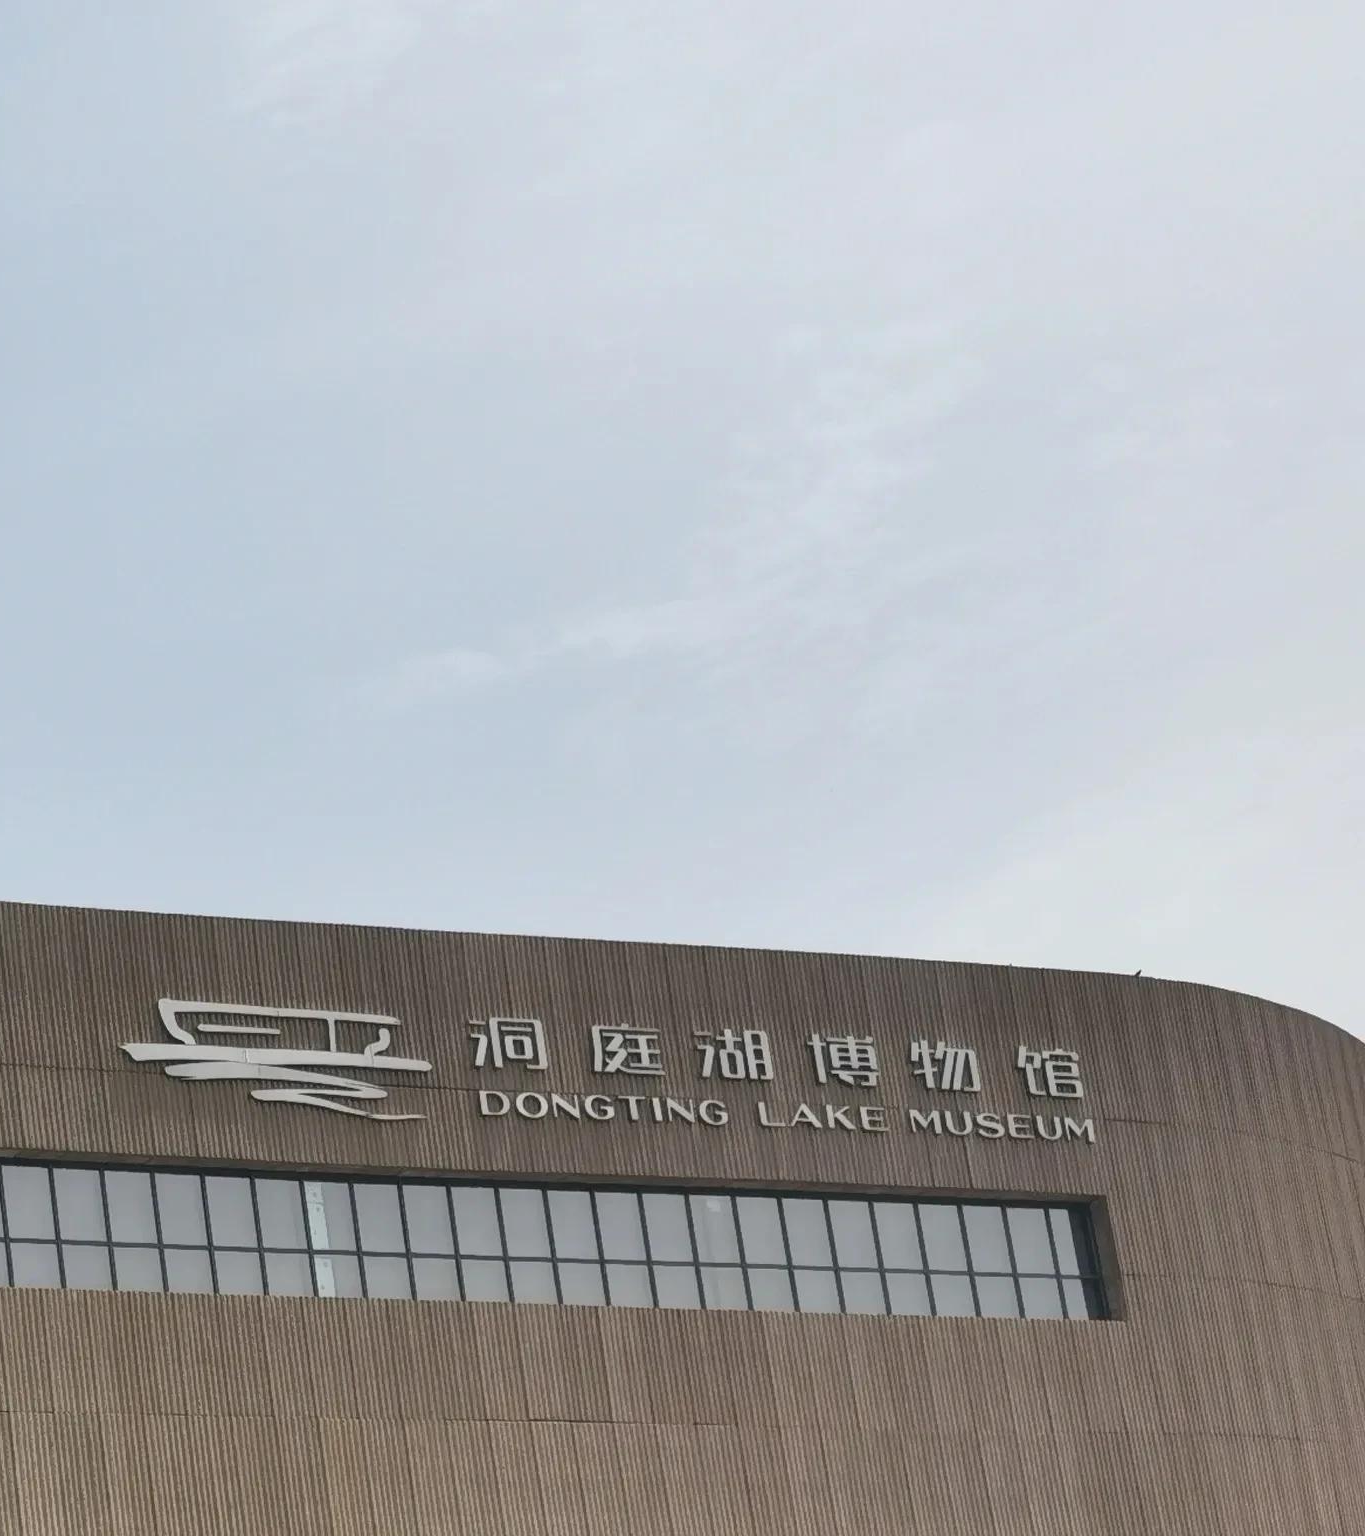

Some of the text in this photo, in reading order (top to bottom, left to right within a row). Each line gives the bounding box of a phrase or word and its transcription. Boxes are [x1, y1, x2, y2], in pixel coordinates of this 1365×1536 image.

[469, 1016, 1085, 1099] 洞庭湖博物馆
[478, 1089, 1097, 1143] DONGTING LAKE MUSEUM
